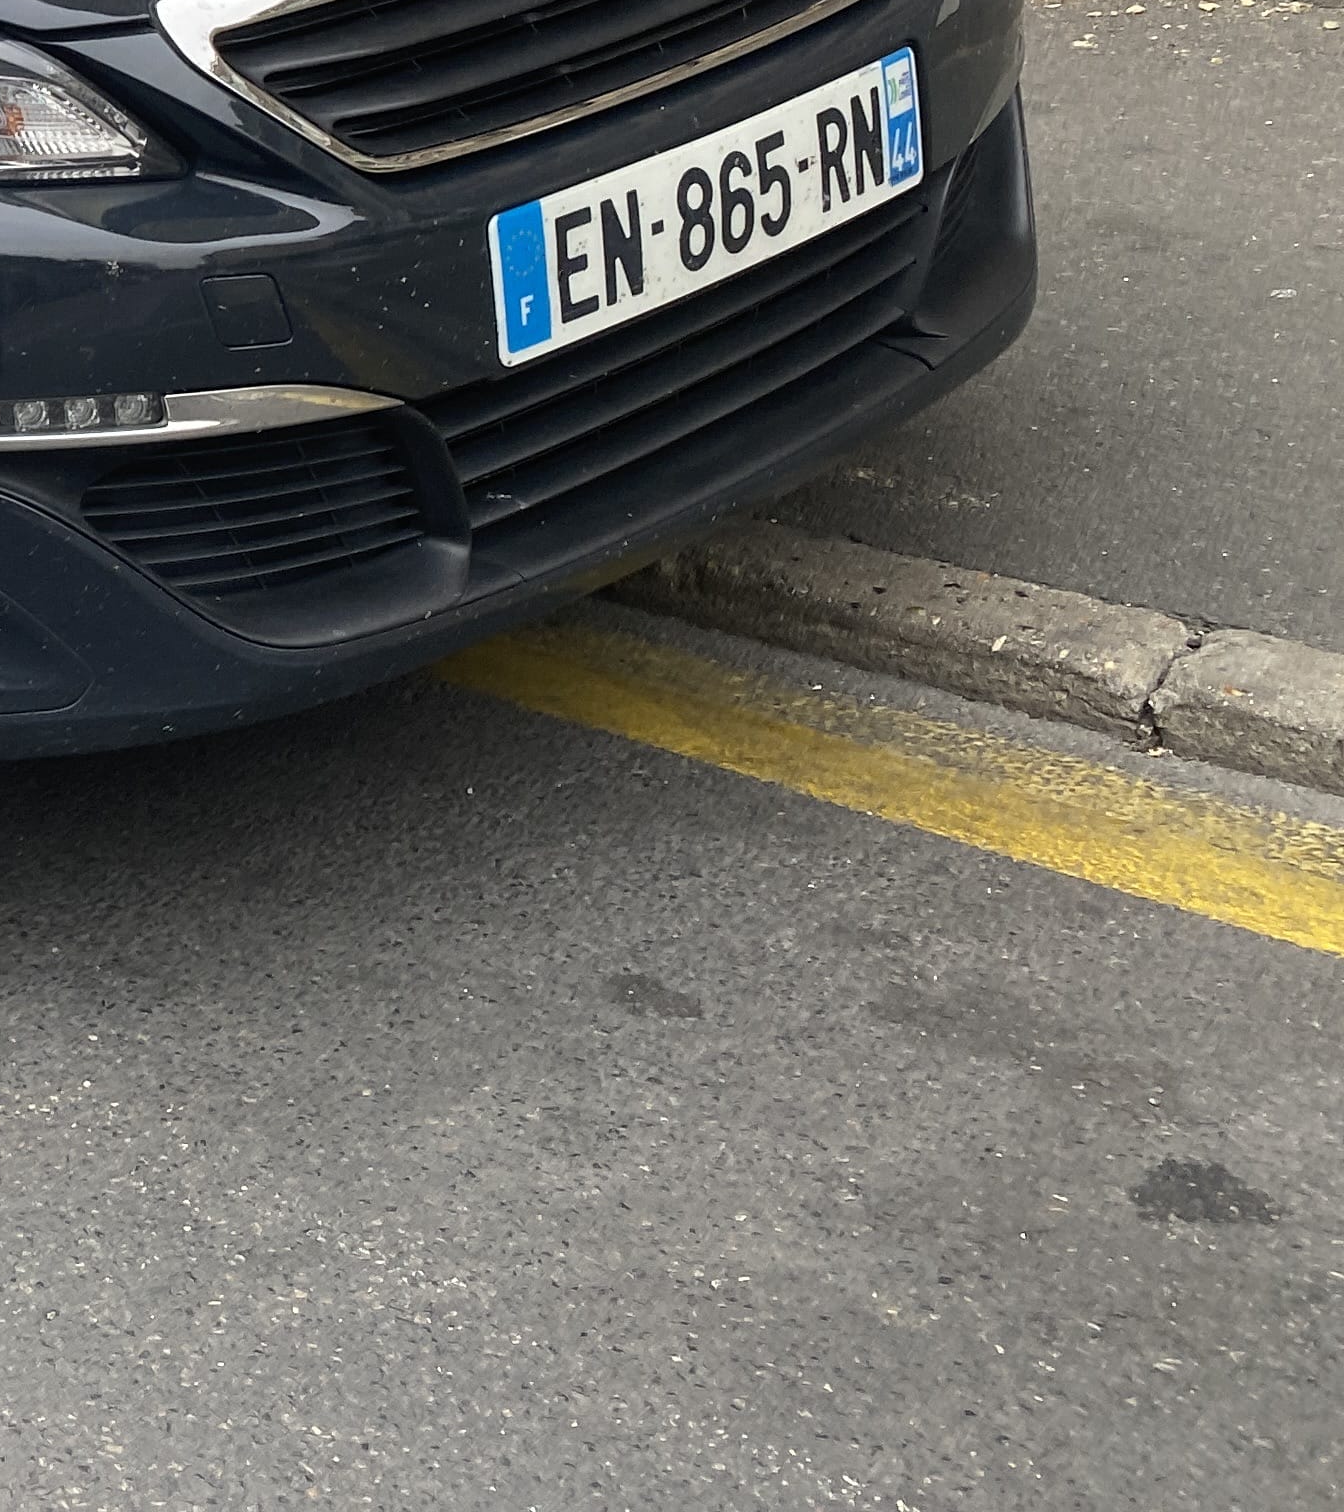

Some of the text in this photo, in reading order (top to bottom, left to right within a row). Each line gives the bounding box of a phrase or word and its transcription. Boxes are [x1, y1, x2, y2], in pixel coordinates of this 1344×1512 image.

[893, 121, 917, 172] 44
[555, 86, 884, 323] EN-865-RN
[520, 294, 534, 326] F
